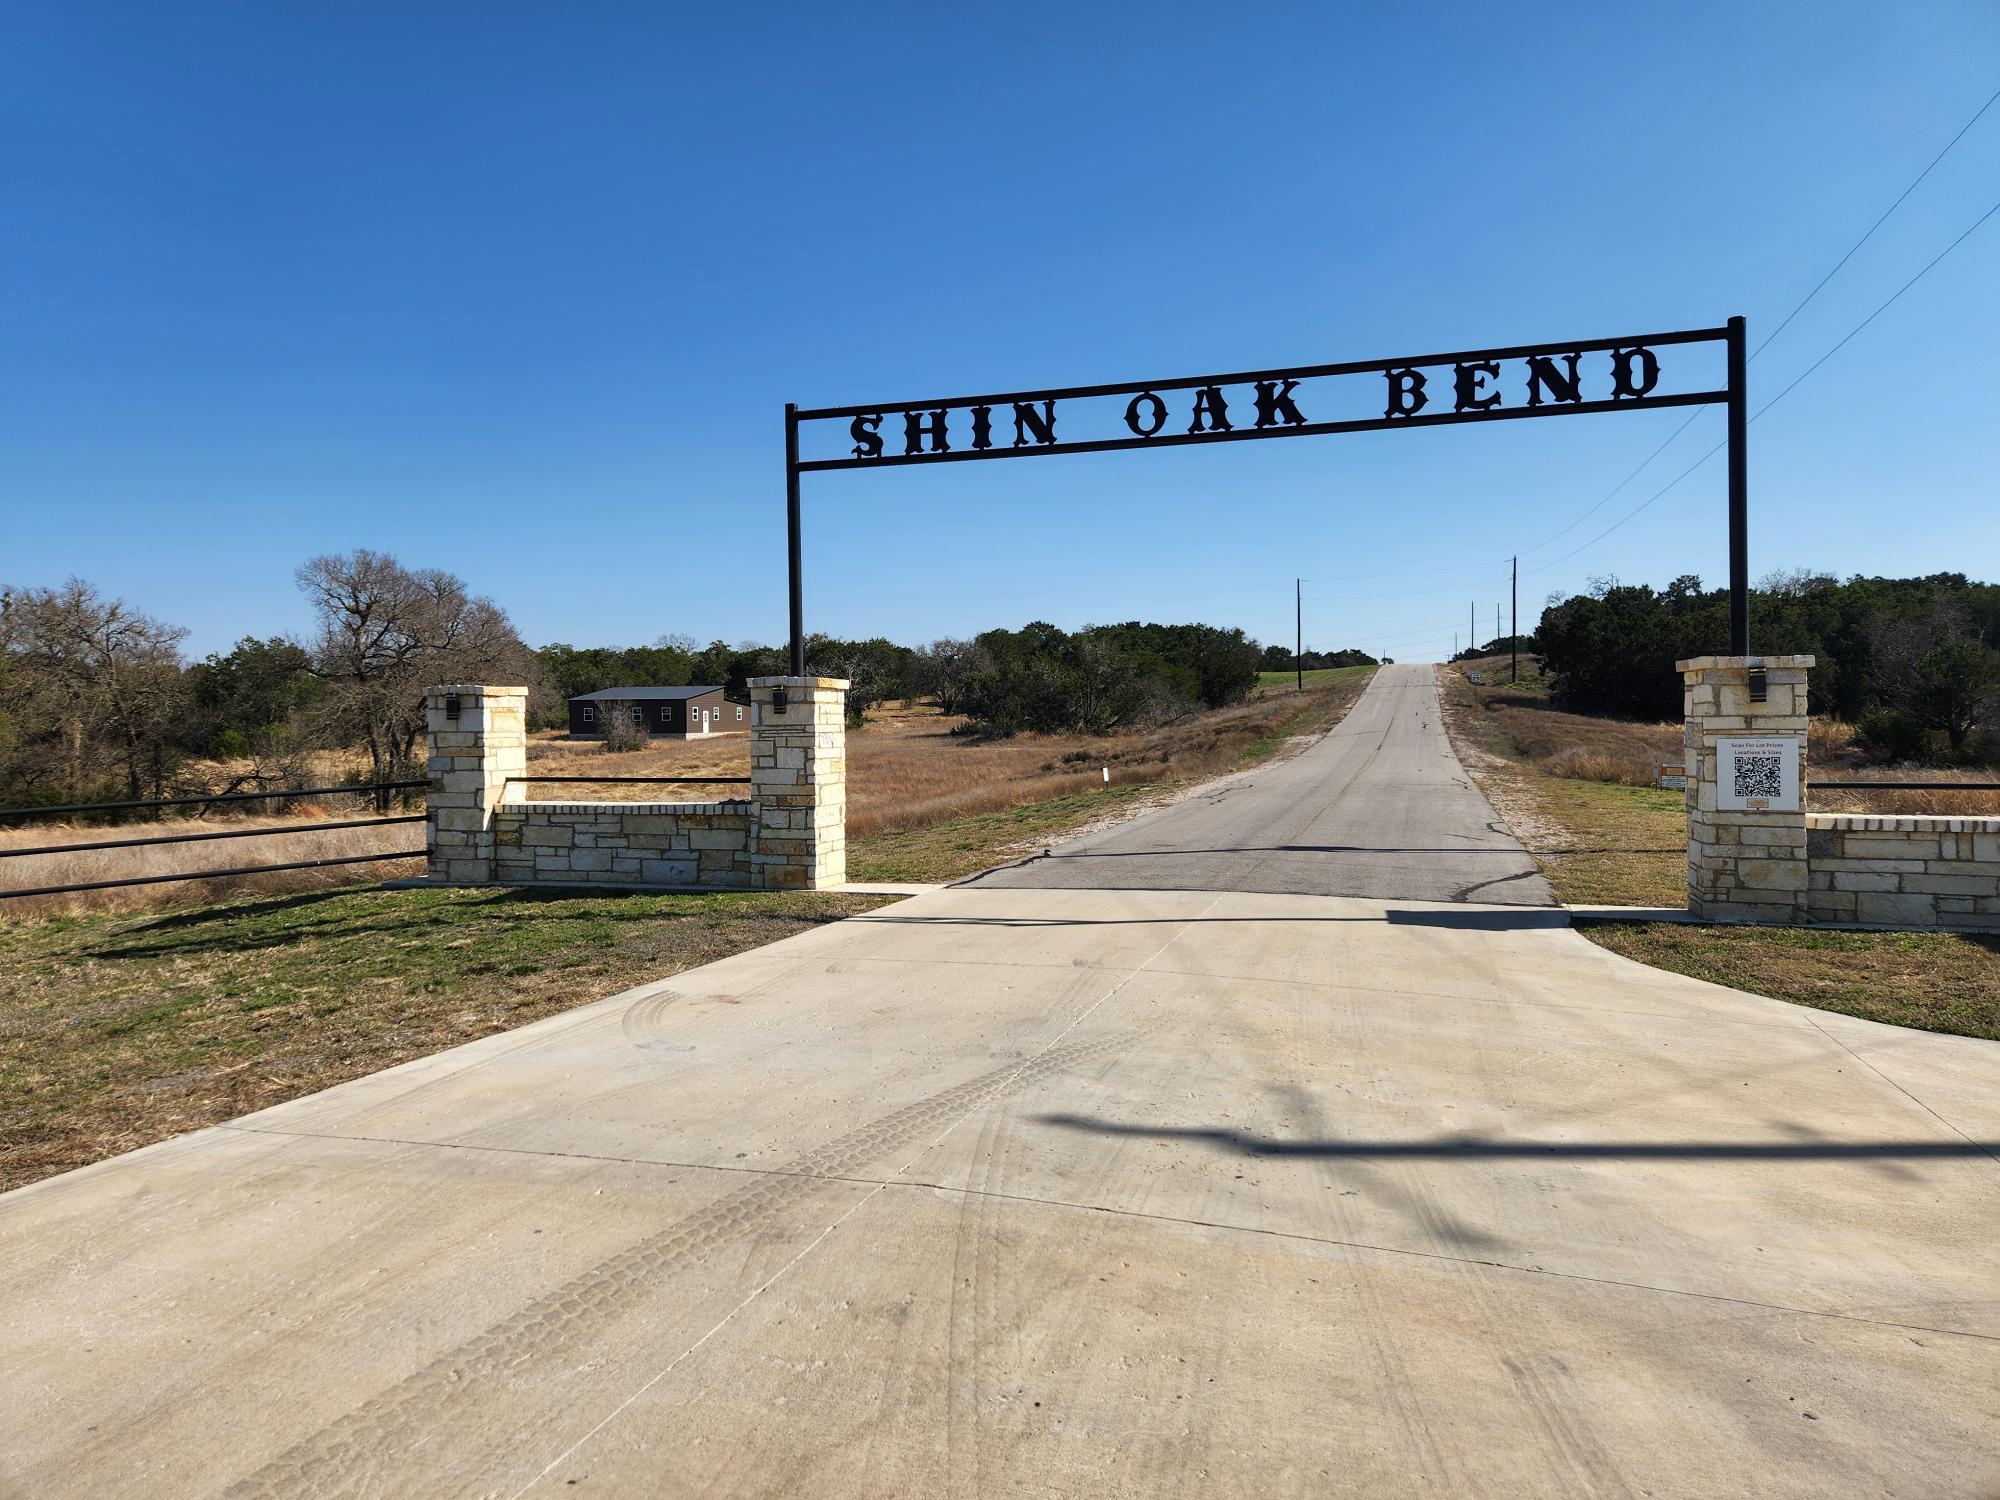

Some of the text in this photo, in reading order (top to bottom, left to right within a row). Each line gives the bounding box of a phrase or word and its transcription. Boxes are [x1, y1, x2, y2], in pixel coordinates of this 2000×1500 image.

[850, 348, 1661, 456] SHIN OAK BEND
